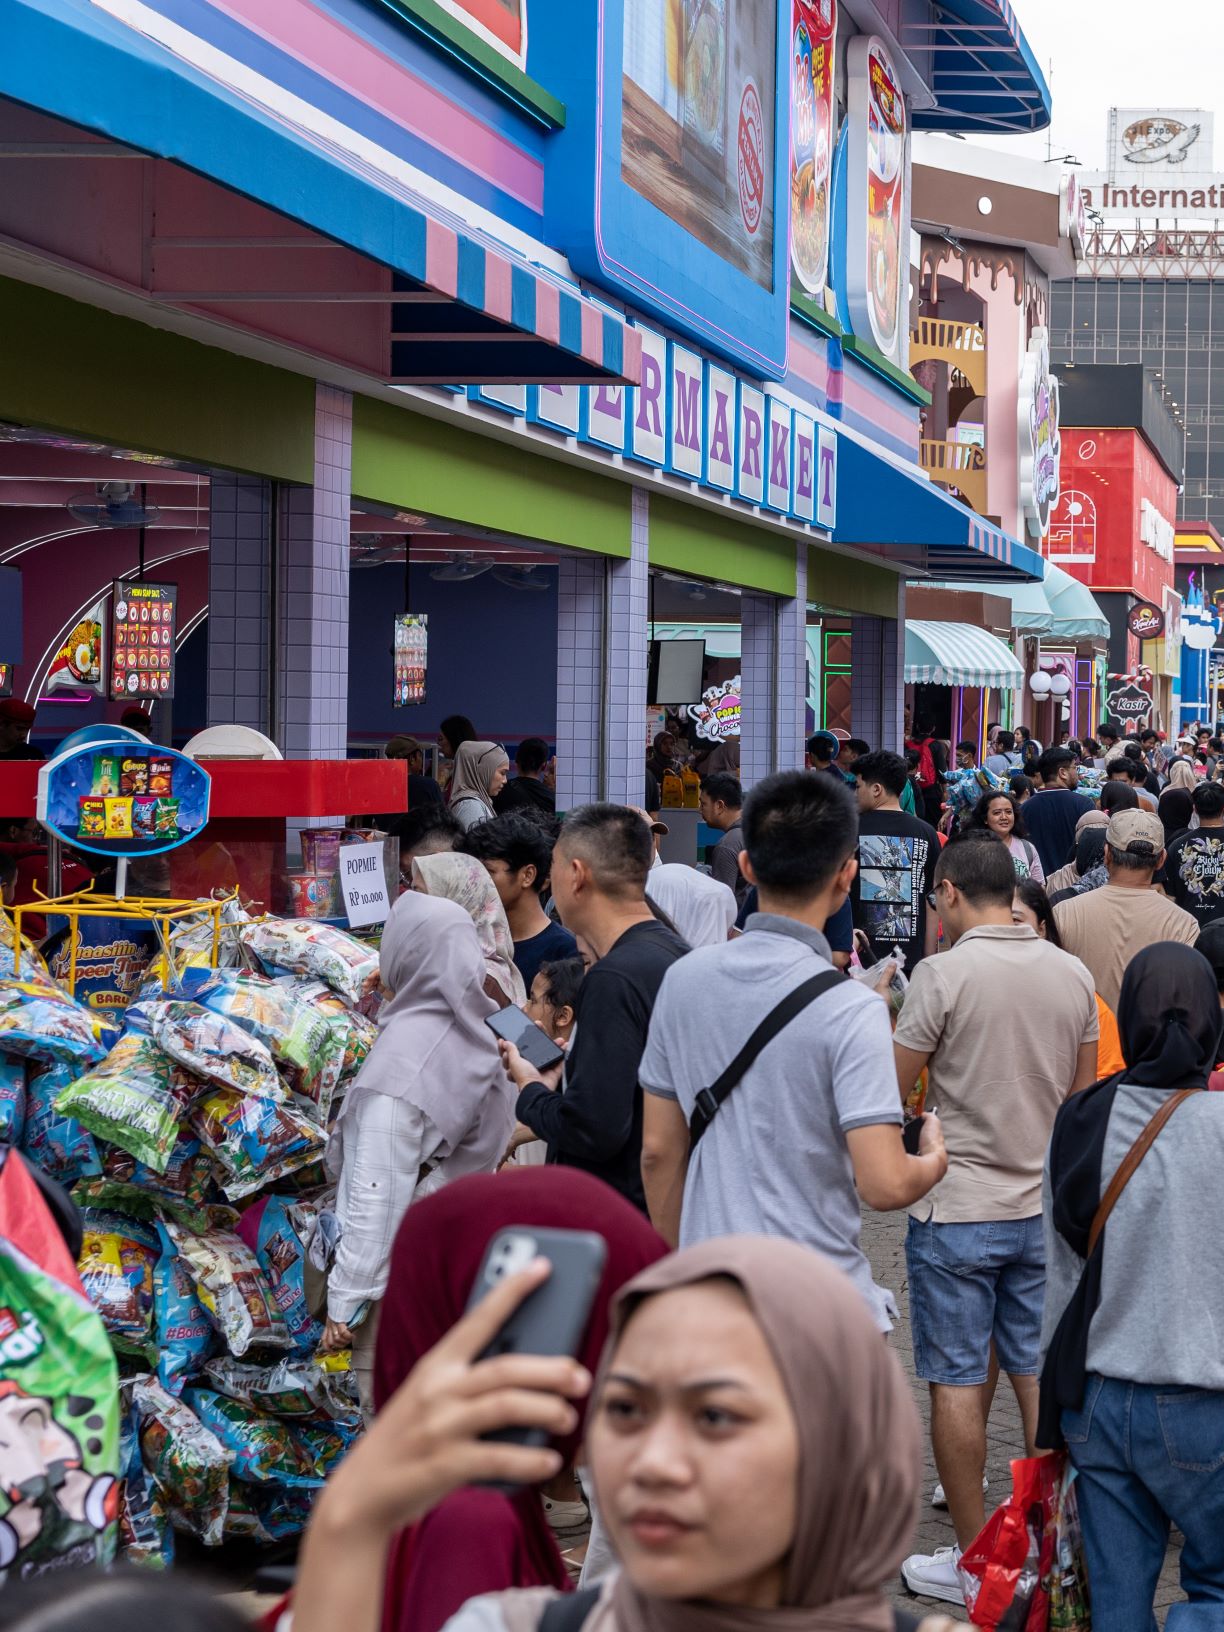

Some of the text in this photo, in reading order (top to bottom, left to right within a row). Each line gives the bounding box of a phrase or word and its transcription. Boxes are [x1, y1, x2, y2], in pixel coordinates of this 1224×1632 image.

[1147, 127, 1171, 137] Expo
[1117, 697, 1148, 711] Kasir
[716, 706, 733, 718] POP
[710, 722, 740, 736] Choco
[84, 802, 103, 810] CHIKI
[347, 856, 377, 875] POPMIE
[349, 890, 384, 907] RP 10.000
[96, 993, 129, 1005] BARU
